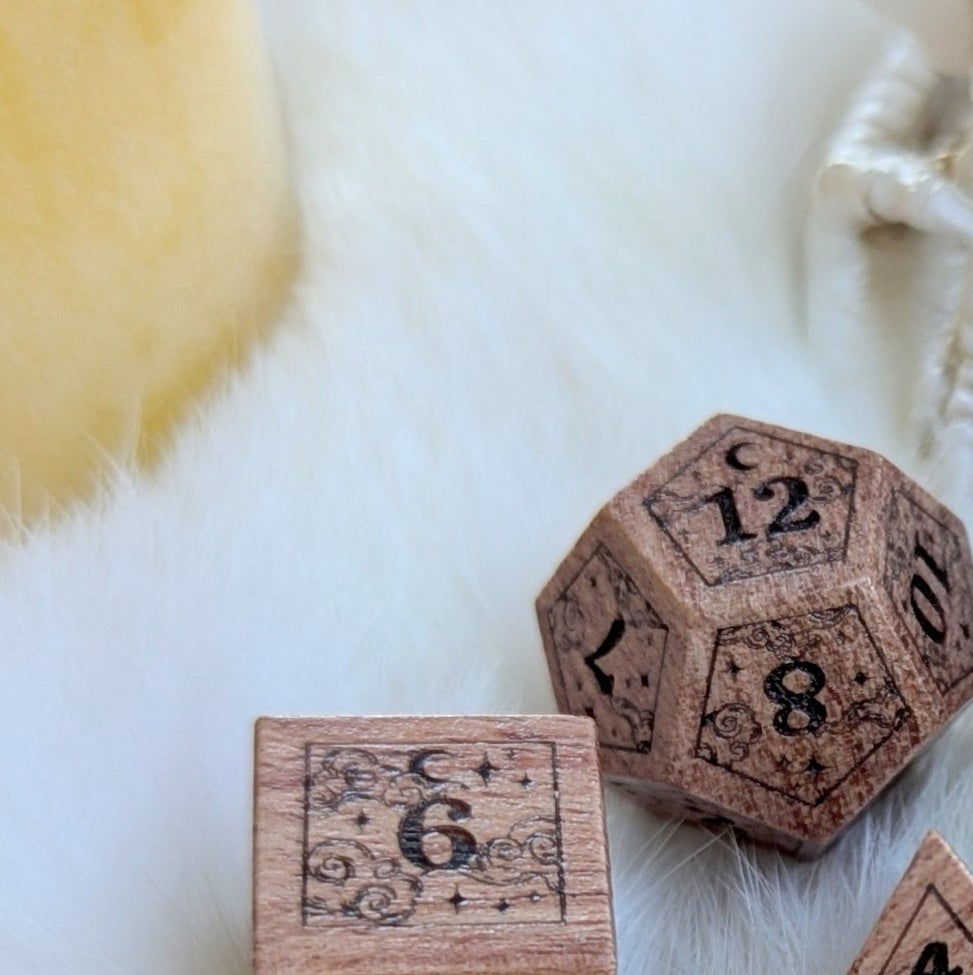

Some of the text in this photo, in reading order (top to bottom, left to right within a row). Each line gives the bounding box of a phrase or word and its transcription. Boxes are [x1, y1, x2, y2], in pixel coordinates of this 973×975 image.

[706, 475, 821, 546] 12
[909, 534, 950, 646] 10
[763, 658, 828, 737] 8
[396, 797, 478, 872] 6
